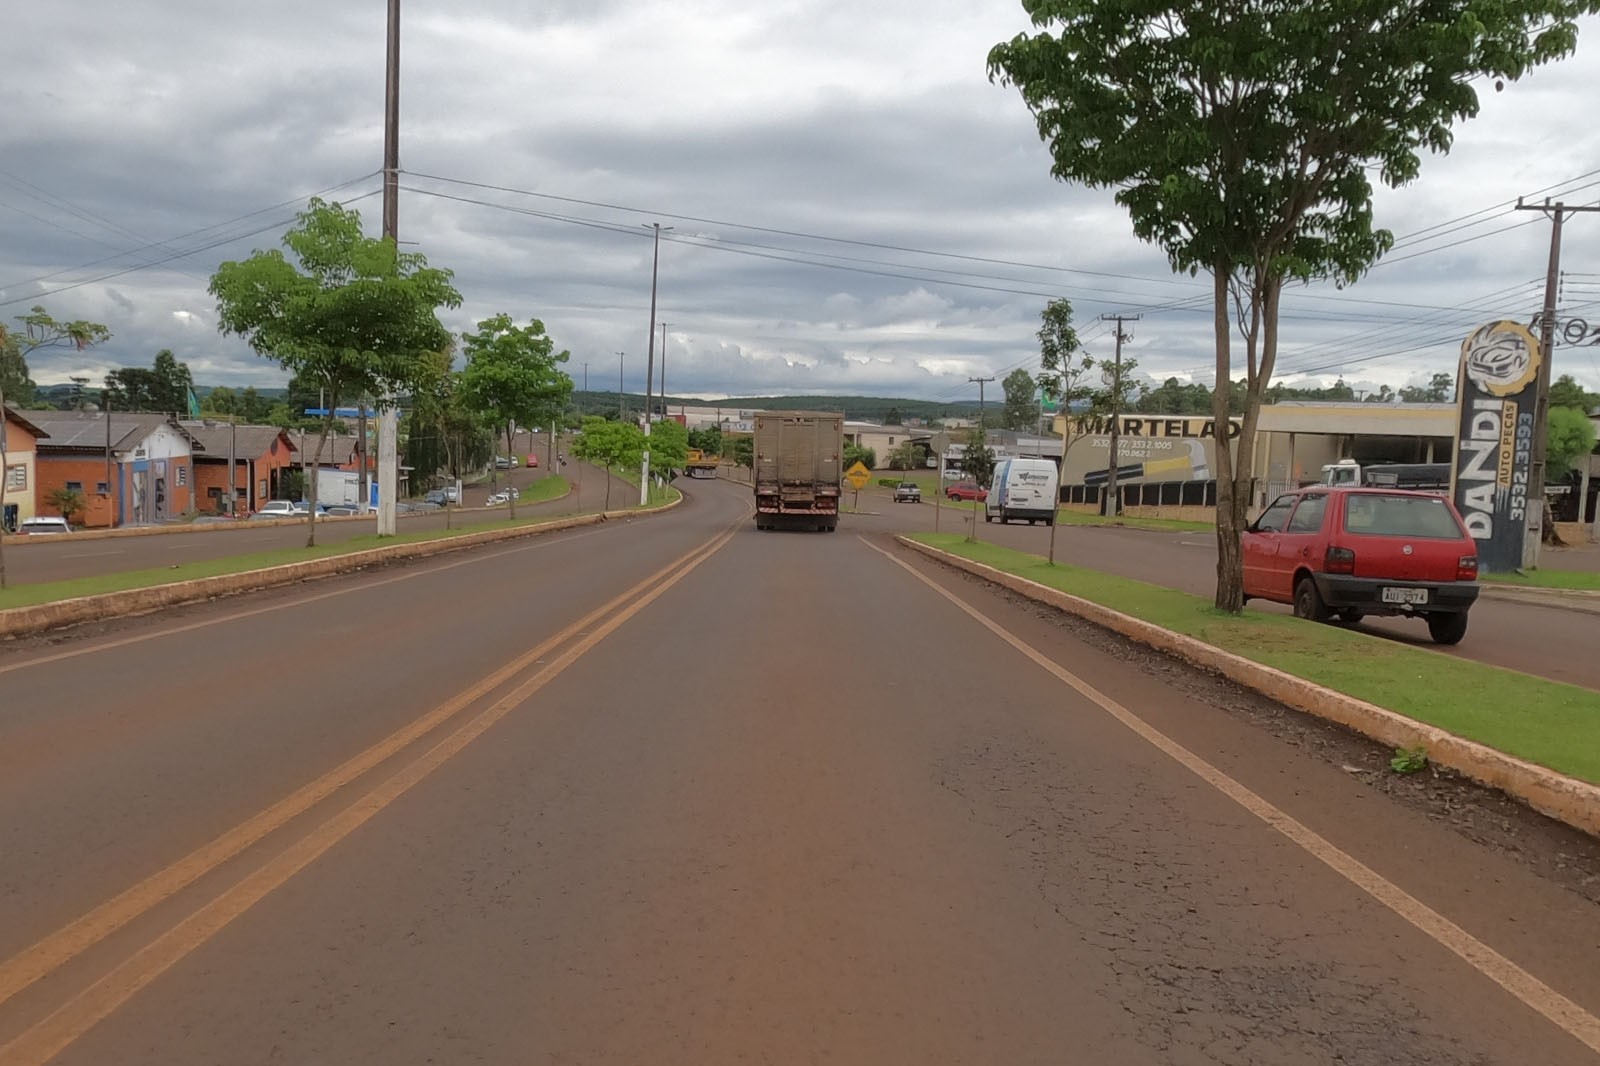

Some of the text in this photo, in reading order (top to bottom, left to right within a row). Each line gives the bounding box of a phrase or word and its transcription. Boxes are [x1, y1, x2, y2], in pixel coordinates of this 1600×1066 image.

[1458, 400, 1503, 539] DANDI
[1500, 450, 1511, 484] AUTO
[1511, 412, 1533, 521] 3532.3593
